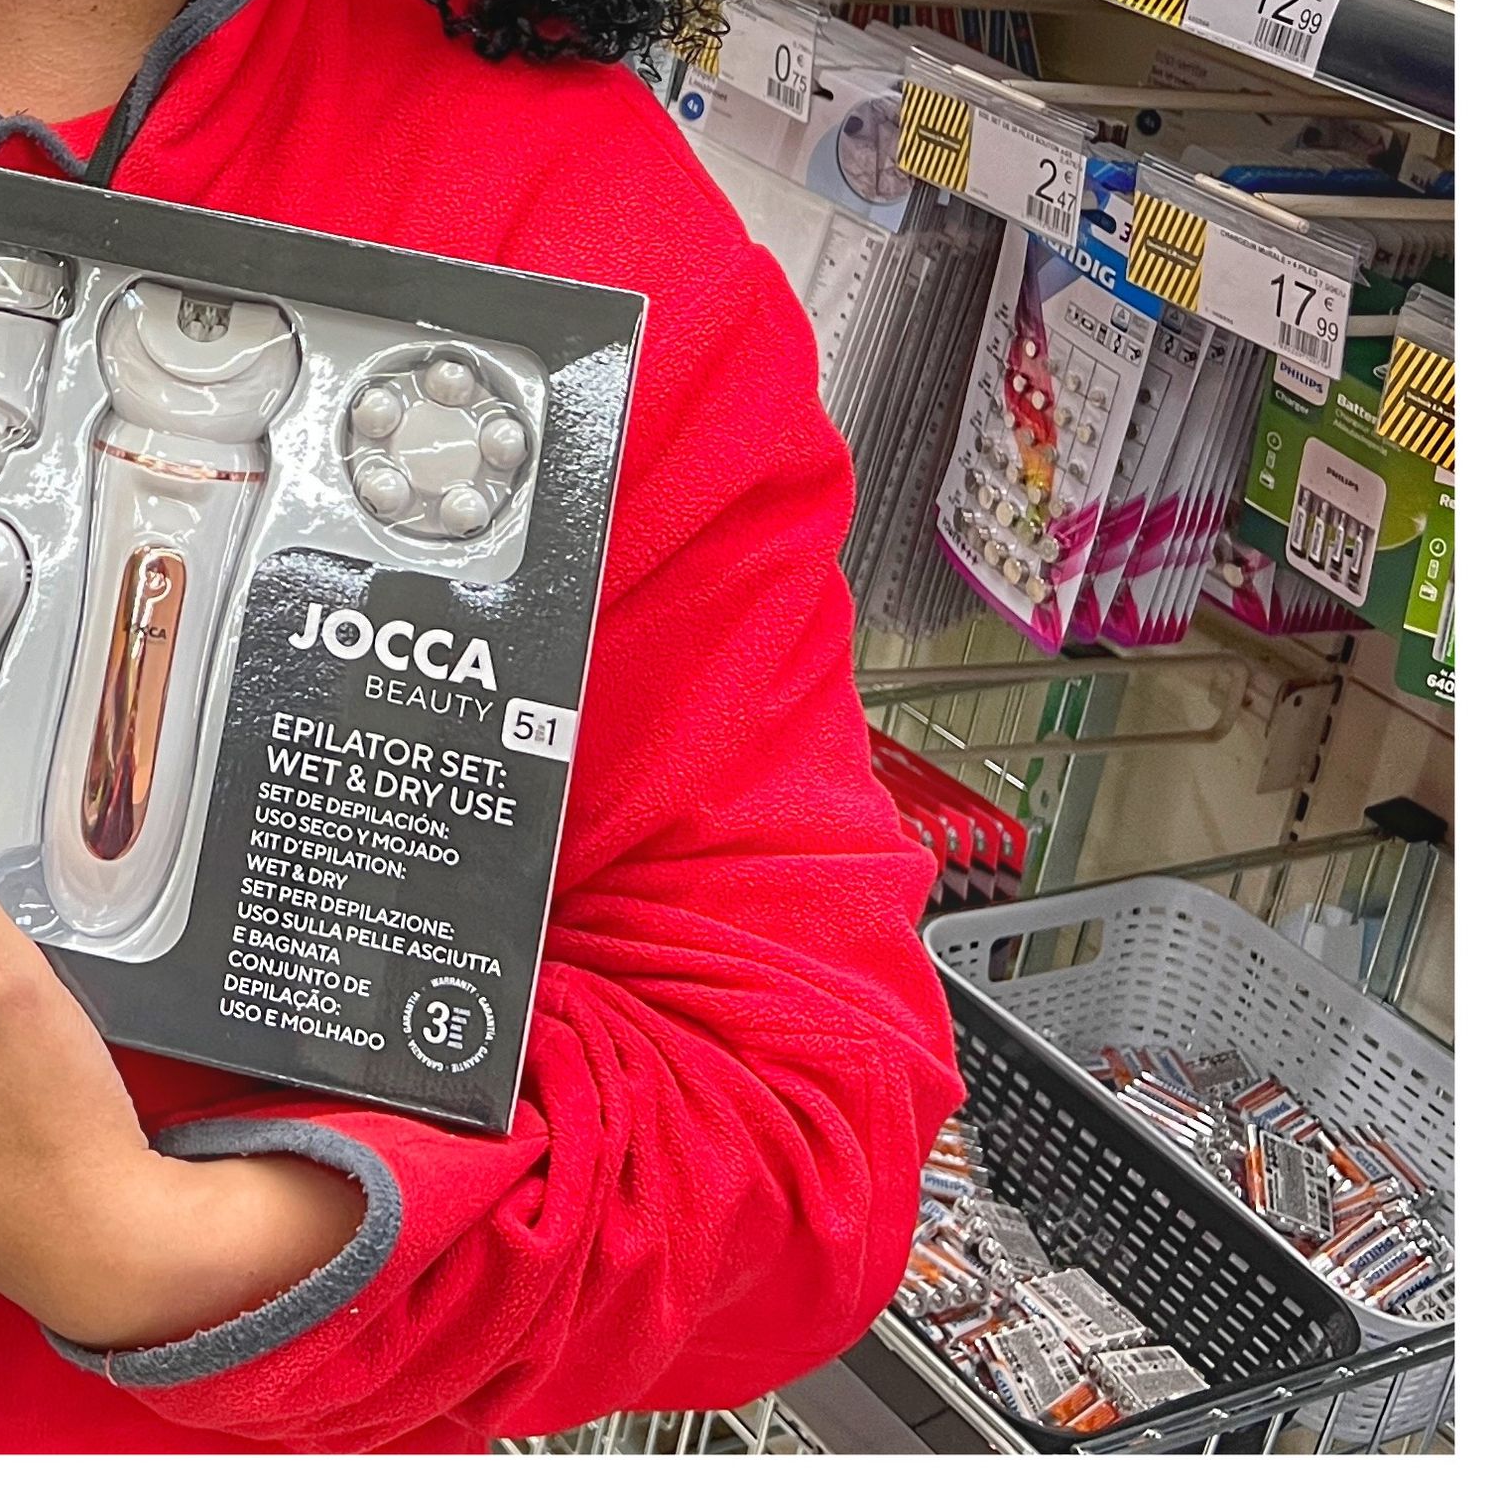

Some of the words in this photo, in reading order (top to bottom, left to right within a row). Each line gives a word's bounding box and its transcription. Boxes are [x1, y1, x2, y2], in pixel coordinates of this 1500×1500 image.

[1298, 8, 1323, 35] 99
[775, 44, 791, 82] 0
[792, 71, 807, 93] 75
[1035, 158, 1058, 203] 2
[1057, 190, 1077, 213] 47
[1270, 273, 1316, 326] 17
[1316, 317, 1339, 343] 99
[1280, 362, 1323, 393] PHILIPS
[1275, 389, 1309, 415] Charger
[288, 602, 497, 691] JOCCA
[365, 674, 493, 722] BEAUTY
[271, 711, 434, 774] EPILATOR
[440, 750, 507, 789] SET:
[267, 744, 342, 786] WET
[346, 764, 367, 793] &
[374, 770, 444, 808] DRY
[450, 786, 517, 826] USE
[258, 782, 294, 804] SET
[296, 790, 323, 811] DE
[325, 797, 450, 840] DEPILACIÓN:
[250, 829, 281, 850] KIT
[283, 836, 407, 881] D'EPILATION:
[255, 805, 297, 830] USO
[298, 816, 353, 842] SECO
[356, 828, 371, 846] Y
[371, 831, 460, 866] MOJADO
[246, 853, 291, 878] WET
[291, 864, 305, 882] &
[307, 867, 349, 891] DRY
[240, 877, 277, 900] SET
[278, 885, 317, 910] PER
[320, 894, 455, 941] DEPILAZIONE:
[233, 925, 247, 944] E
[248, 930, 341, 966] BAGNATA
[237, 901, 279, 925] USO
[281, 911, 342, 941] SULLA
[346, 925, 406, 954] PELLE
[406, 940, 502, 977] ASCIUTTA
[223, 973, 342, 1017] DEPILAÇÃO:
[228, 950, 340, 989] CONJUNTO
[343, 976, 372, 998] DE
[430, 976, 478, 994] WARRANTY
[219, 998, 262, 1022] USO
[265, 1009, 278, 1027] E
[280, 1012, 386, 1052] MOLHADO
[422, 1000, 450, 1045] 3
